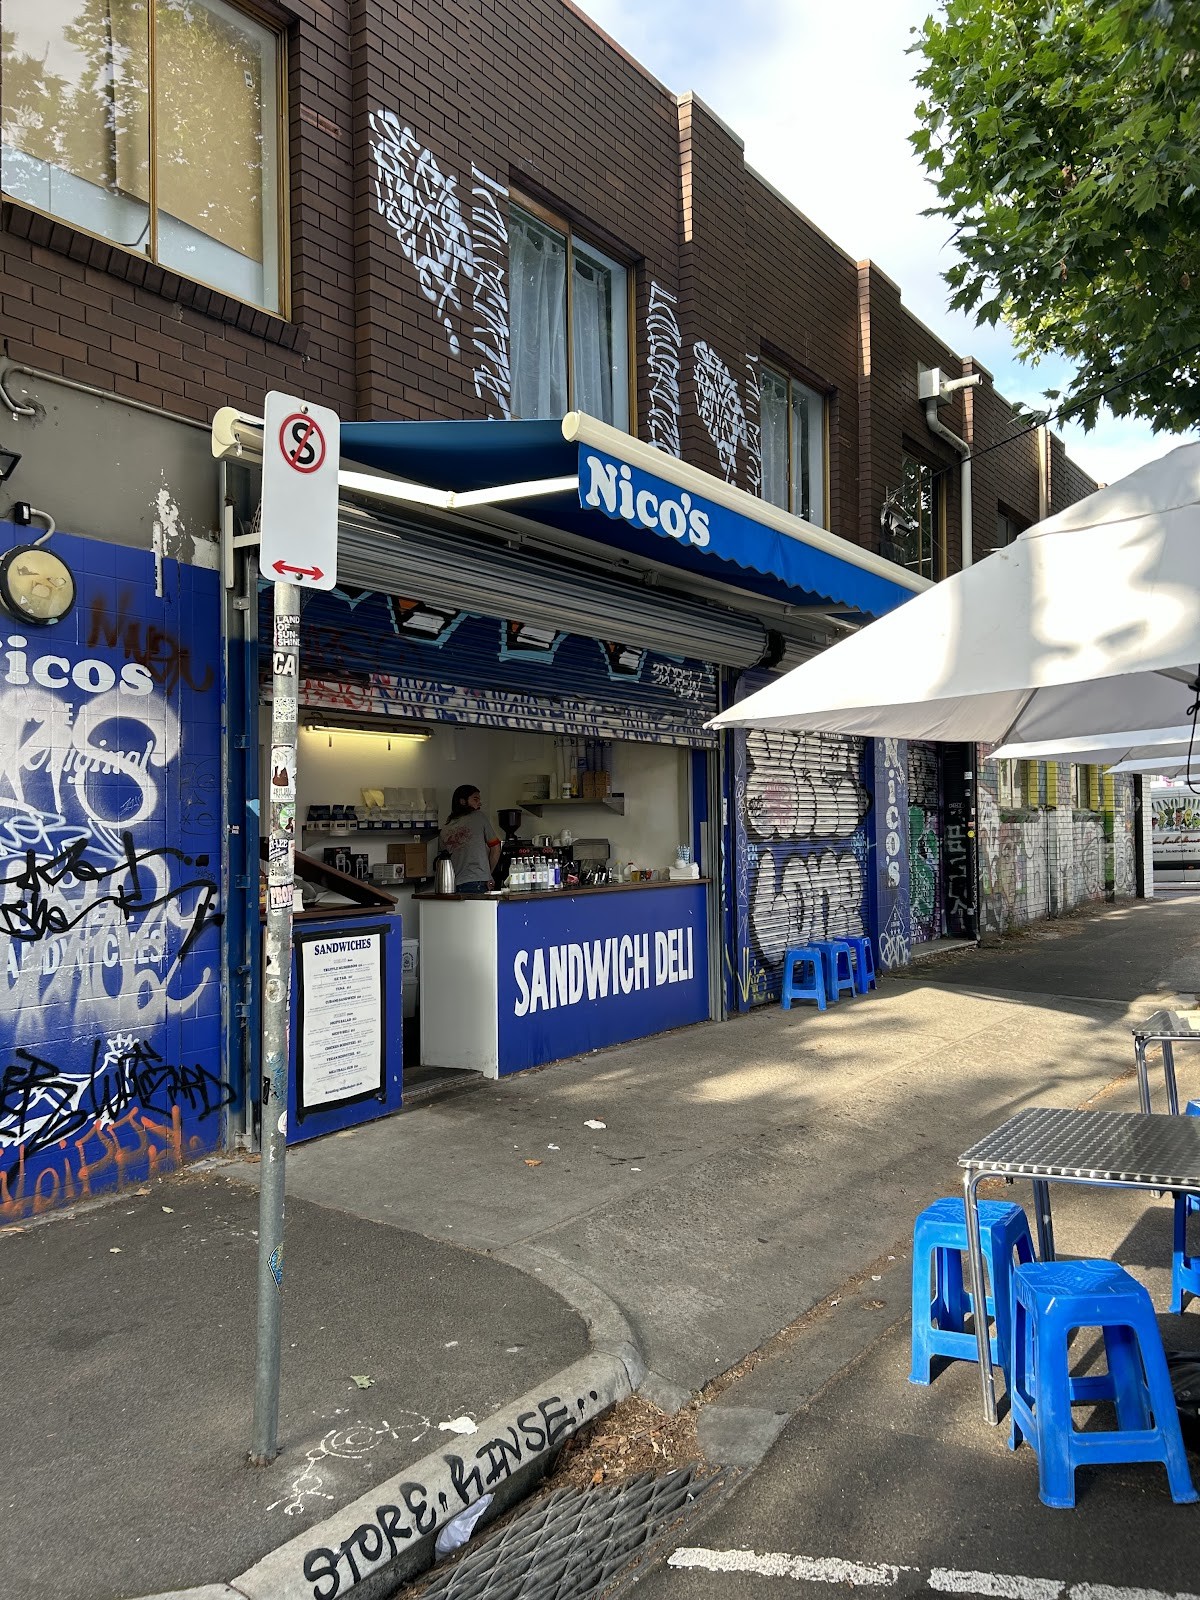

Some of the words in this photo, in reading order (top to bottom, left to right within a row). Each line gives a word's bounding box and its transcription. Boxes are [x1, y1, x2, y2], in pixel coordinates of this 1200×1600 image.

[585, 455, 711, 547] Nico's
[276, 615, 300, 624] LAND
[276, 623, 291, 631] OF
[277, 630, 299, 639] SUN-
[0, 635, 154, 696] icos
[314, 938, 372, 956] SANDWICHES
[513, 933, 650, 1017] SANDWICH
[654, 926, 694, 986] DELI
